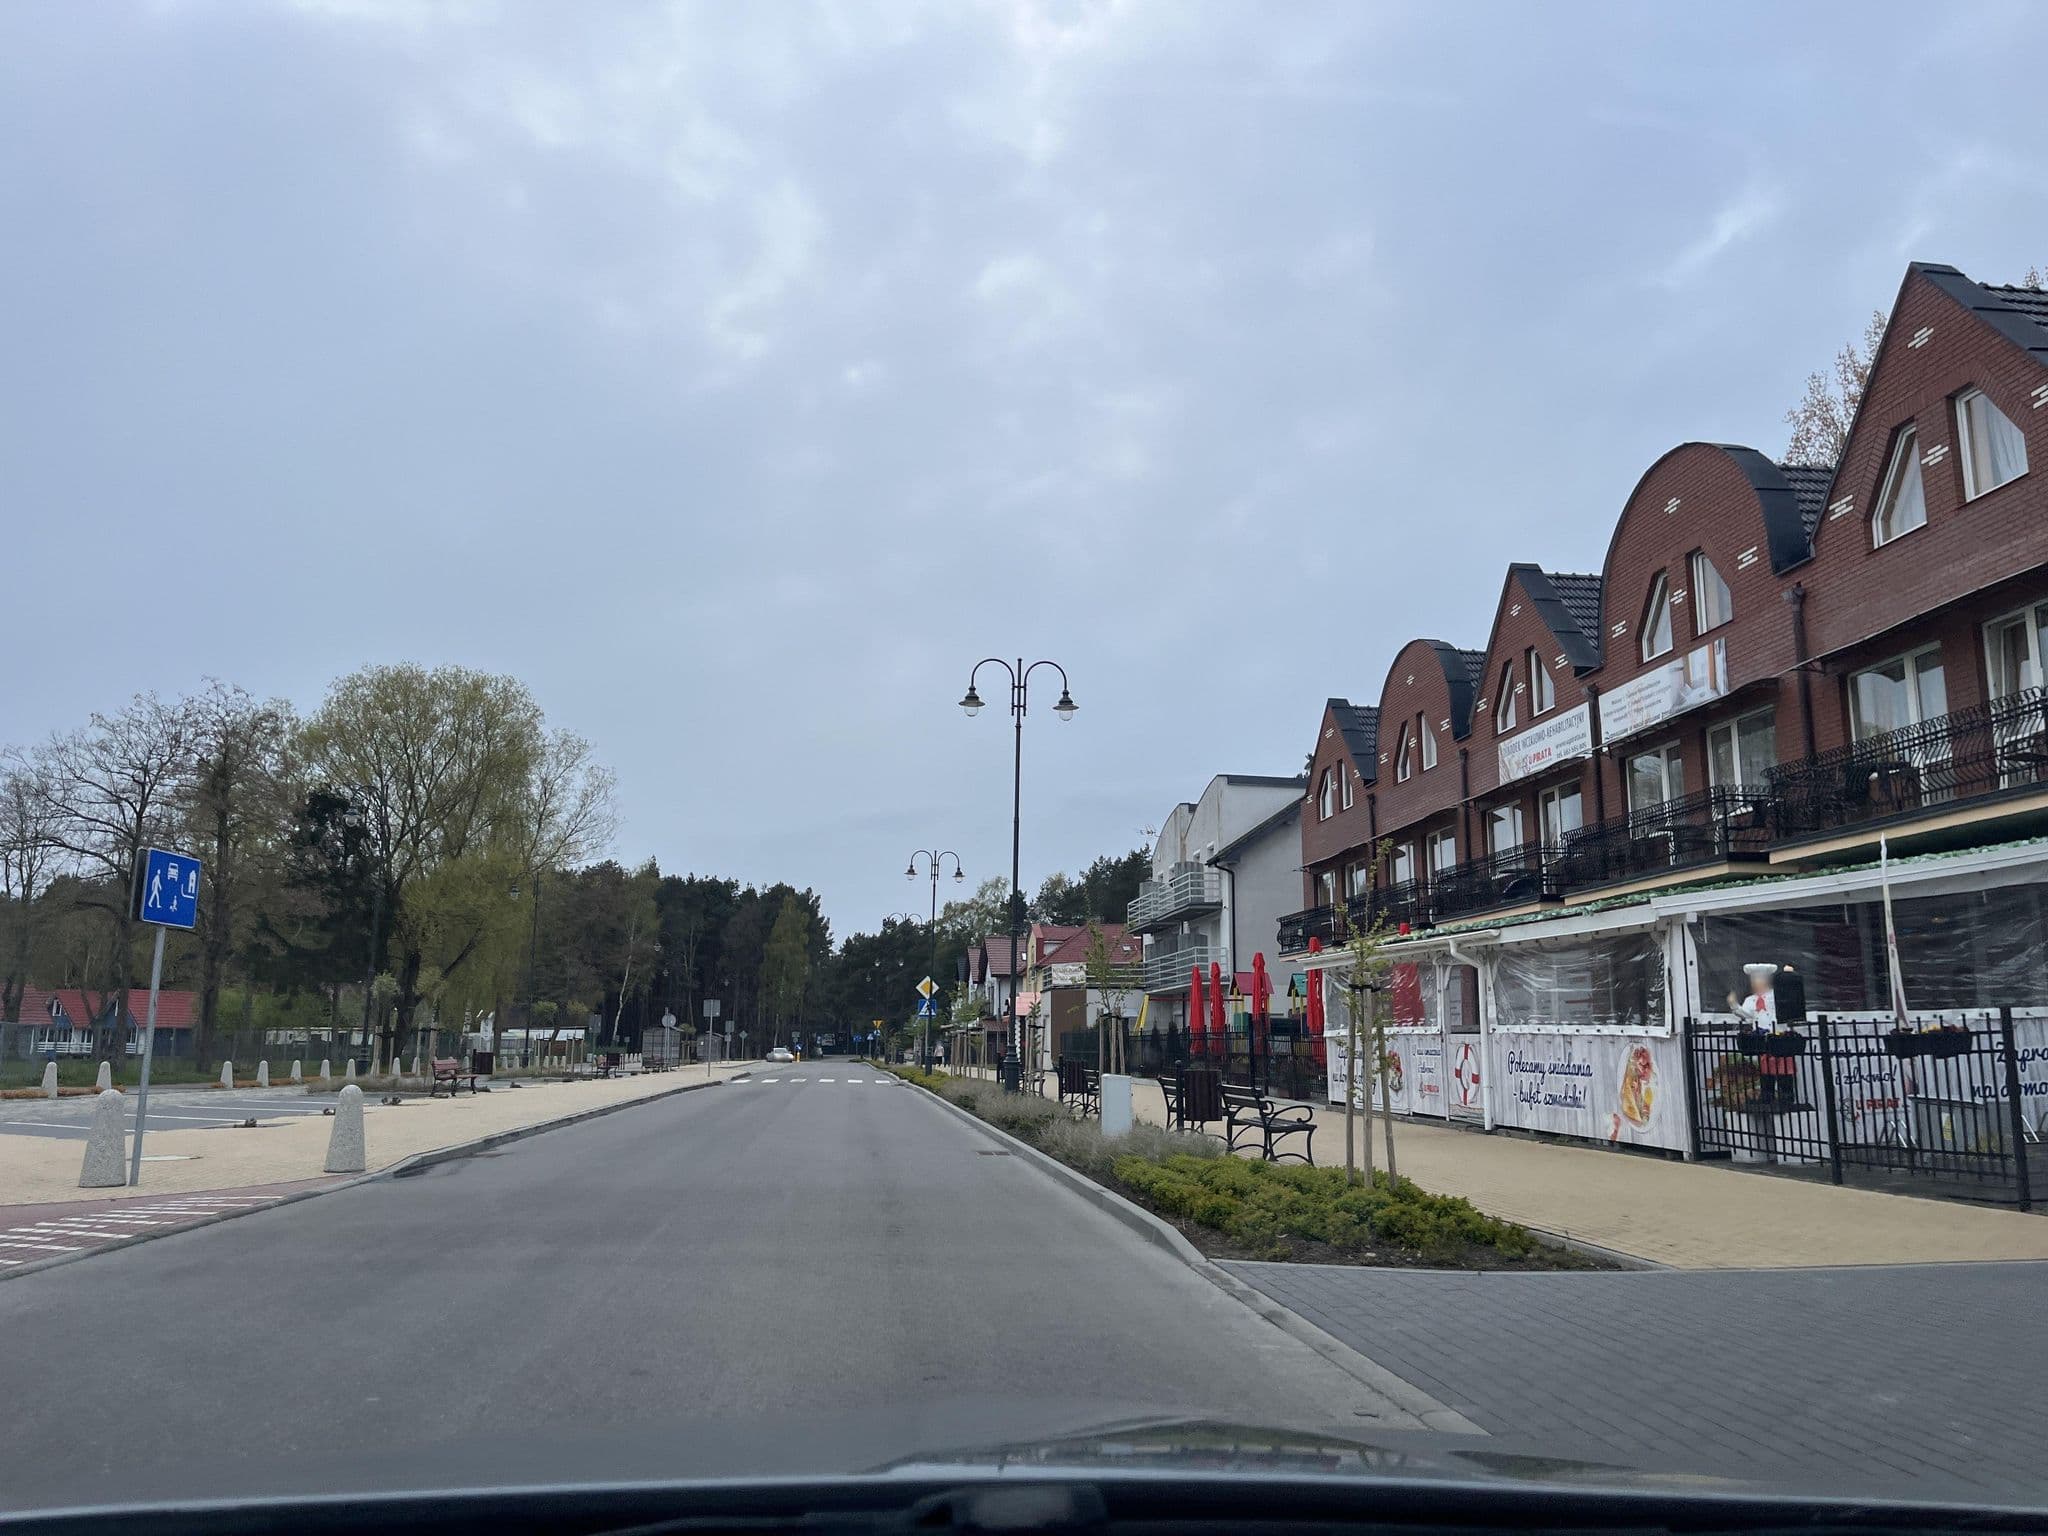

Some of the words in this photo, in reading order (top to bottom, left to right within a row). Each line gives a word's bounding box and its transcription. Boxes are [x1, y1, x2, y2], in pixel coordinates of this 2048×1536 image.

[1508, 1050, 1546, 1085] Polecamy
[1547, 1052, 1593, 1077] śniadania
[1519, 1080, 1542, 1111] bufet
[1866, 1097, 1906, 1110] PIRAT
